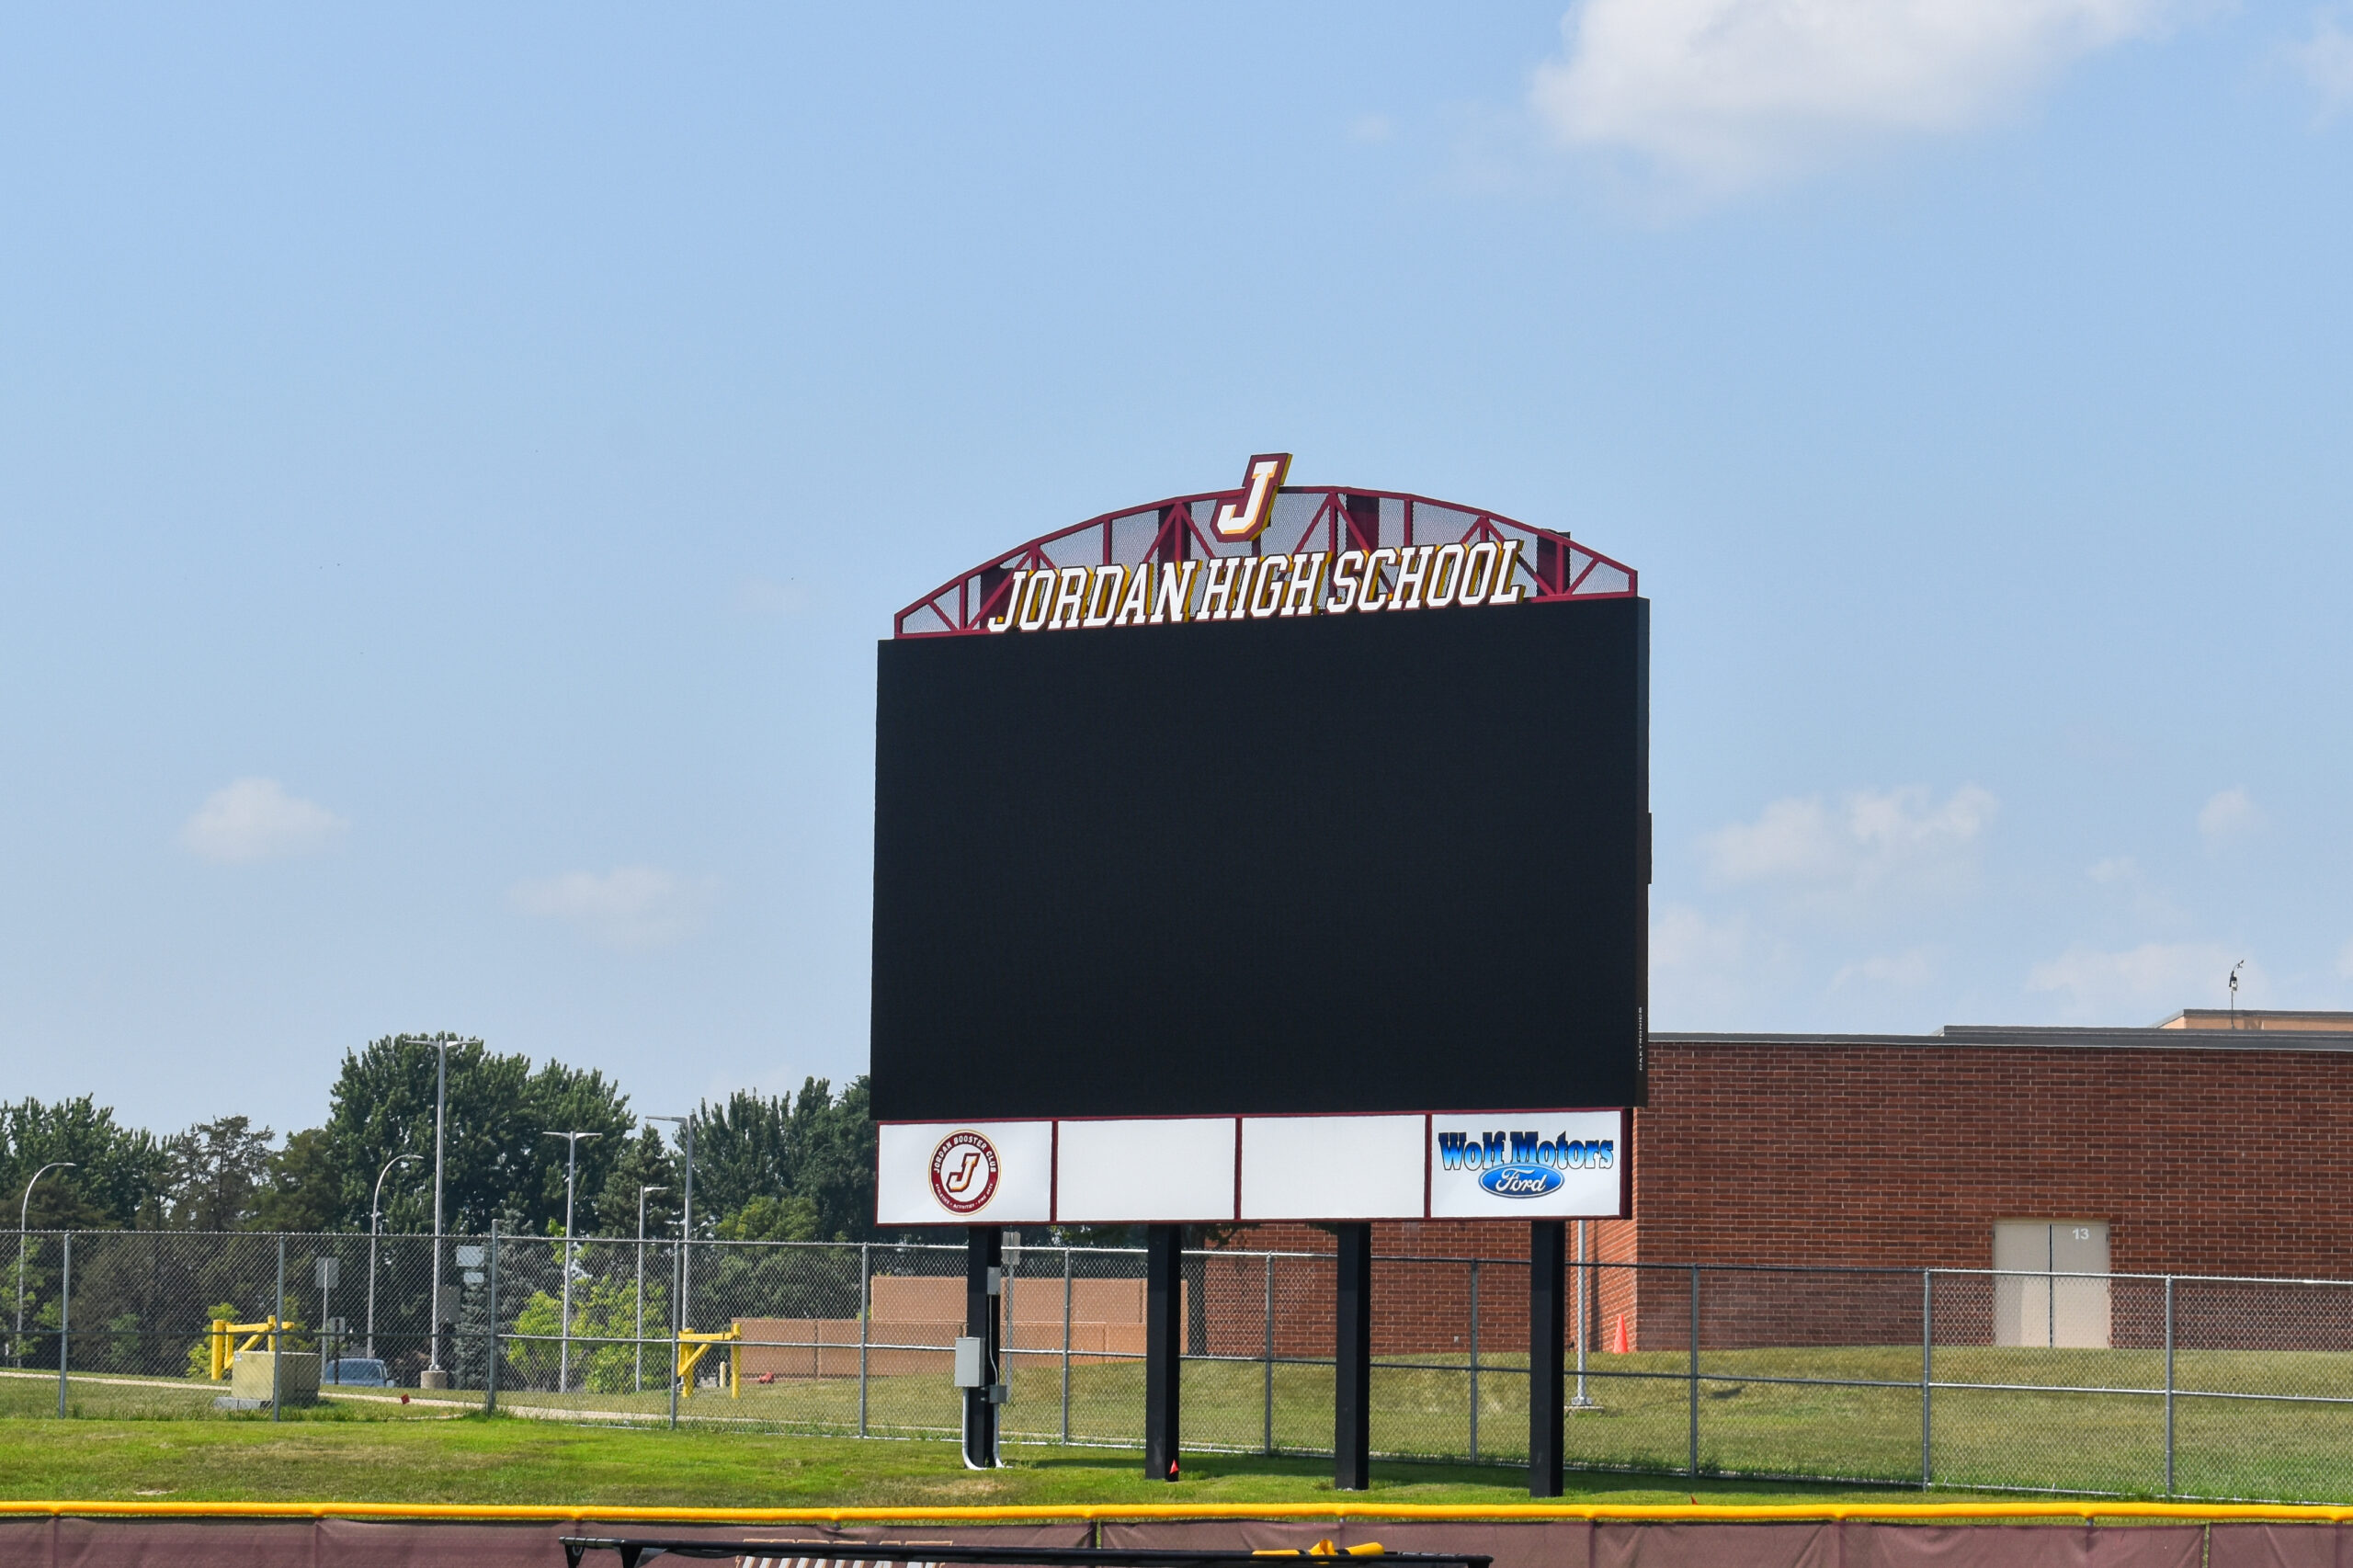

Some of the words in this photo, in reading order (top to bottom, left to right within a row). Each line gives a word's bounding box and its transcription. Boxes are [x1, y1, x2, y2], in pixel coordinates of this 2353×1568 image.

[1210, 453, 1290, 542] J
[986, 559, 1199, 632] JORDAN
[1195, 551, 1328, 622] HIGH
[1325, 539, 1521, 613] SCHOOL
[934, 1141, 953, 1174] JORDAN
[953, 1135, 987, 1151] BOOSTER
[985, 1150, 997, 1173] CLUB
[1438, 1131, 1506, 1171] Wolf
[1510, 1131, 1614, 1170] Motors
[946, 1153, 981, 1193] J
[1495, 1168, 1547, 1193] Ford
[2072, 1227, 2089, 1240] 13
